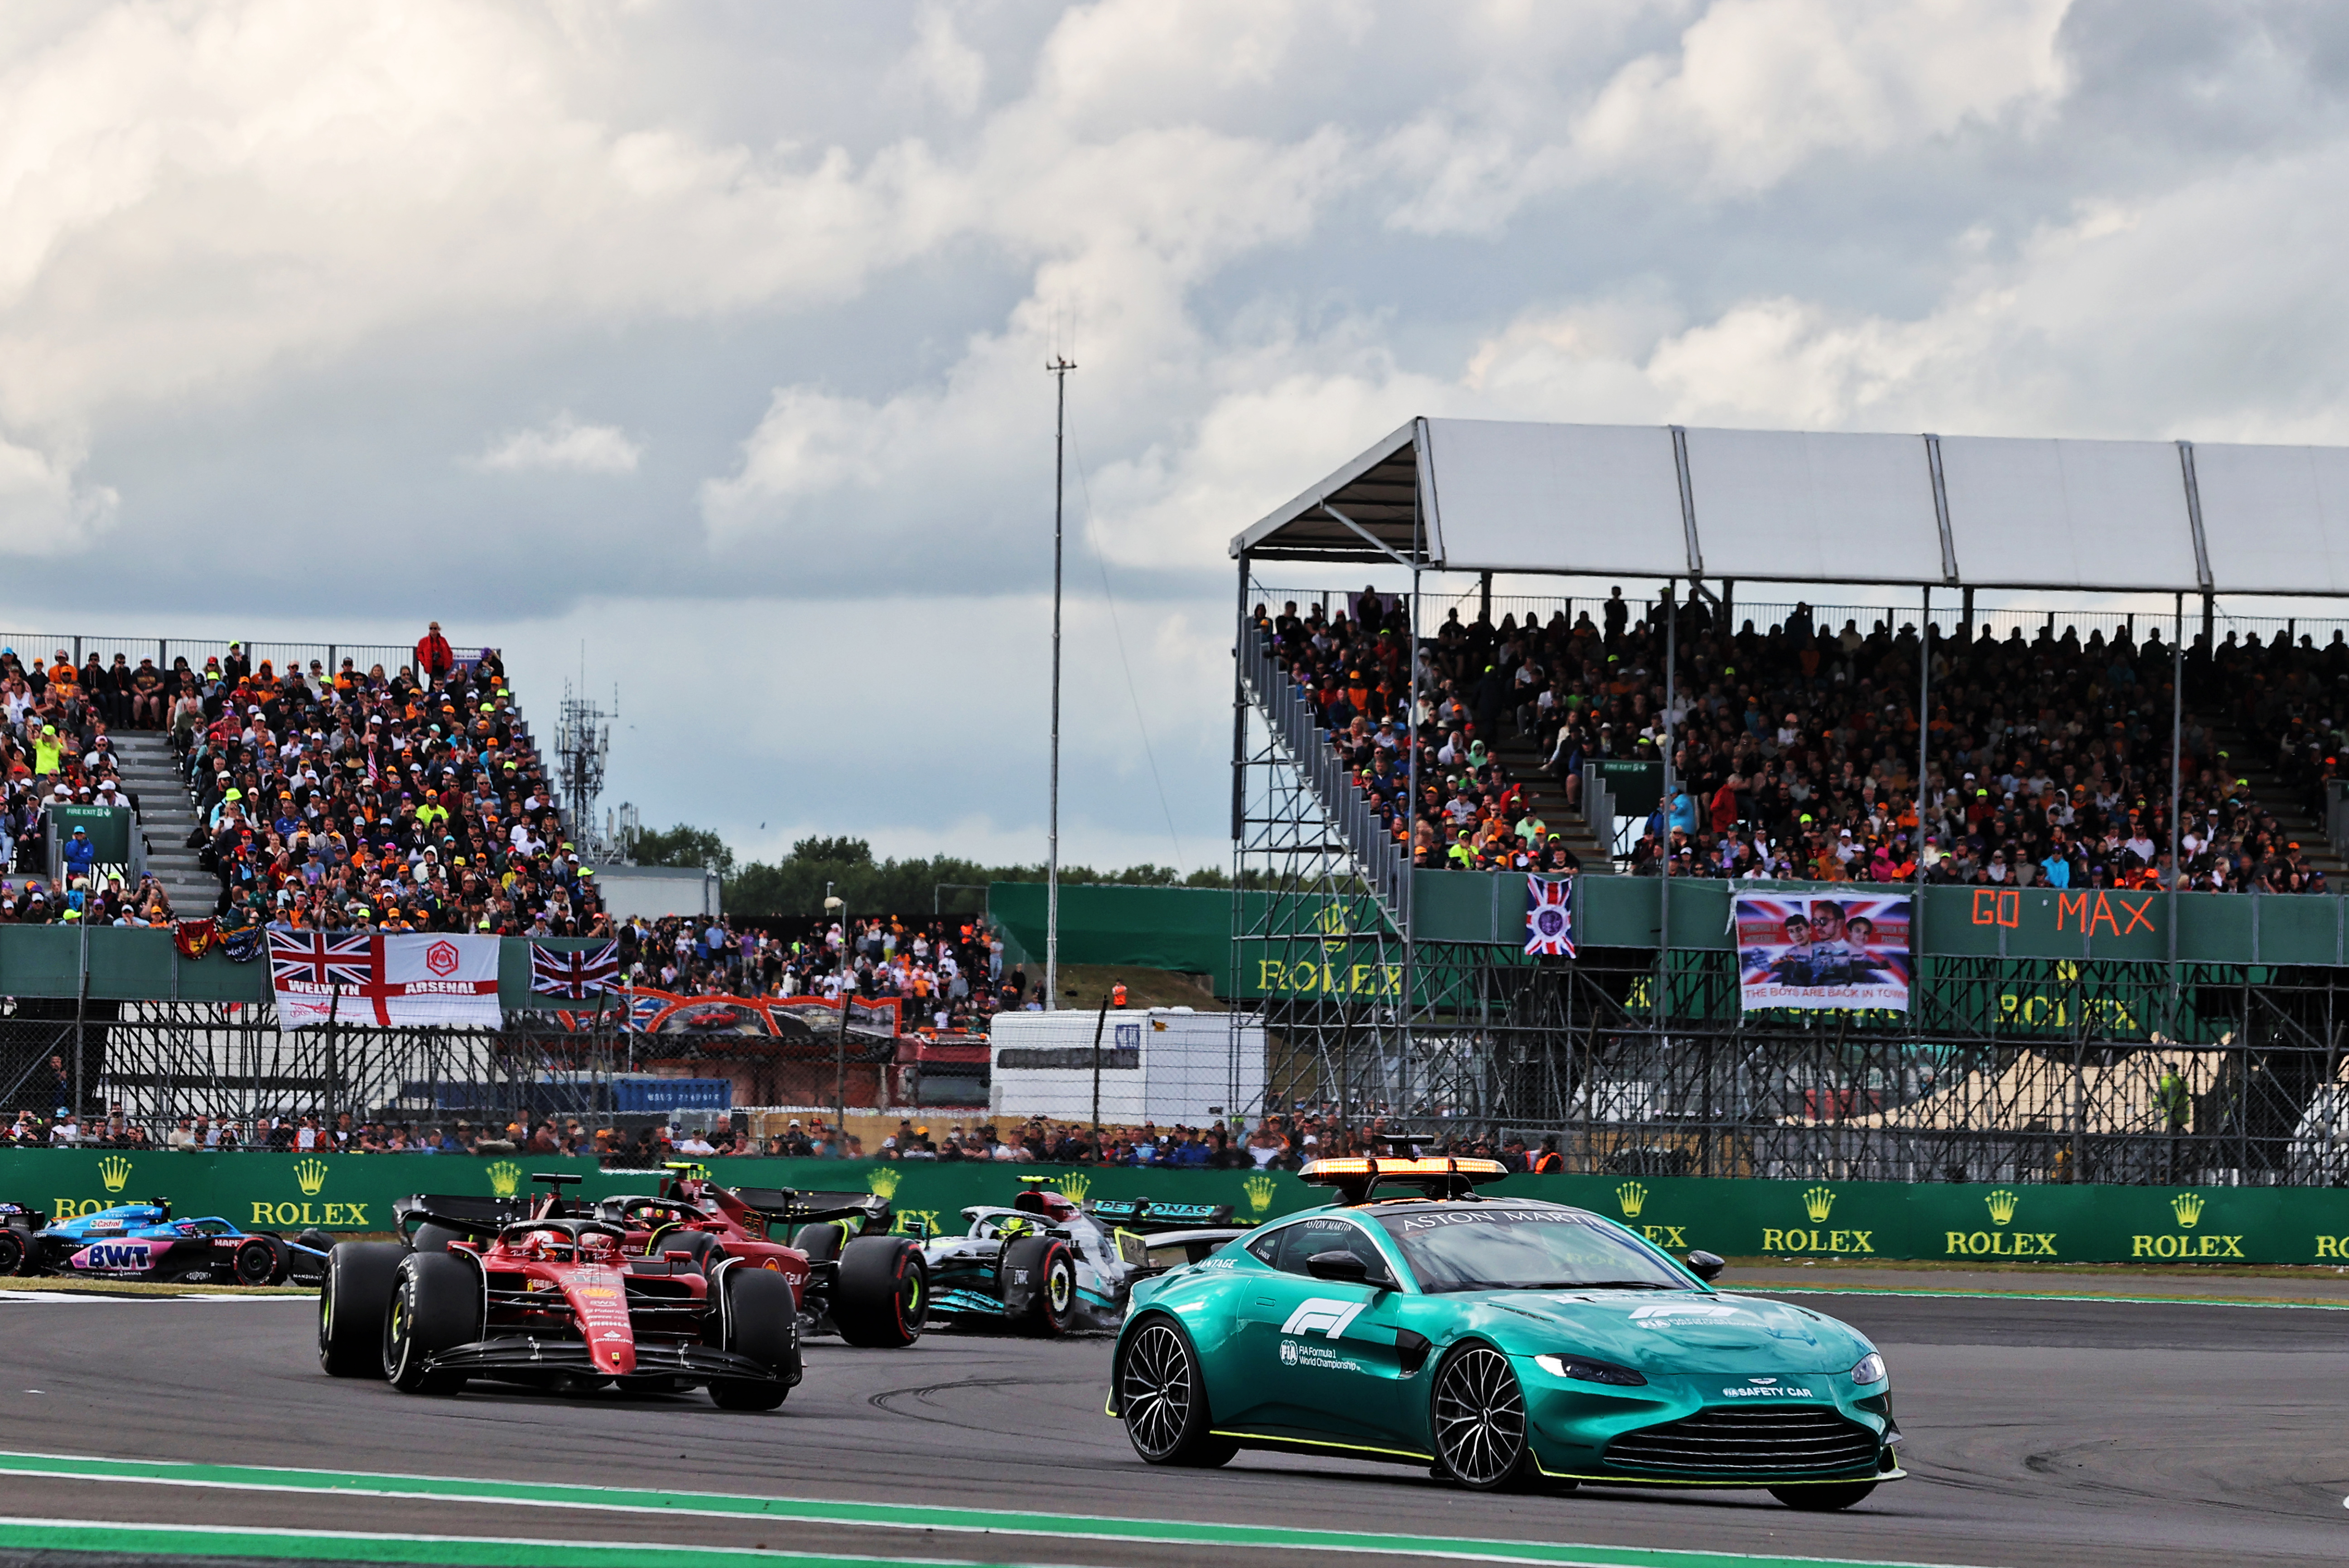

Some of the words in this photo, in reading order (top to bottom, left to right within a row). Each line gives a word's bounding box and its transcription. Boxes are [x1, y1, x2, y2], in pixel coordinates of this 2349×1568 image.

[1973, 889, 2020, 928] GO
[2057, 891, 2156, 936] MAX
[1258, 960, 1402, 995] ROLEX
[288, 979, 360, 996] WELWYN
[405, 981, 477, 994] ARSENAL
[1745, 989, 1766, 998] THE
[1770, 987, 1799, 997] BOYS
[1803, 988, 1825, 997] ARE
[1828, 988, 1859, 998] BACK
[1862, 989, 1873, 997] IN
[251, 1201, 369, 1225] ROLEX
[1101, 1202, 1209, 1213] PETONAS
[1304, 1220, 1326, 1229] ASTON
[1328, 1221, 1353, 1232] MARTIN
[1404, 1211, 1496, 1231] ASTON
[1503, 1211, 1616, 1230] MARTIN
[1762, 1228, 1874, 1253] ROLEX
[1945, 1231, 2057, 1255] ROLEX
[2132, 1235, 2245, 1258] ROLEX
[89, 1245, 149, 1268] BWT
[1281, 1344, 1297, 1360] FIA
[1299, 1346, 1308, 1355] FIA
[1309, 1347, 1332, 1358] Formula
[1332, 1349, 1336, 1358] 1
[1299, 1355, 1316, 1366] World
[1317, 1358, 1356, 1371] Championship
[1738, 1387, 1784, 1396] SAFETY
[1787, 1388, 1813, 1397] CAR
